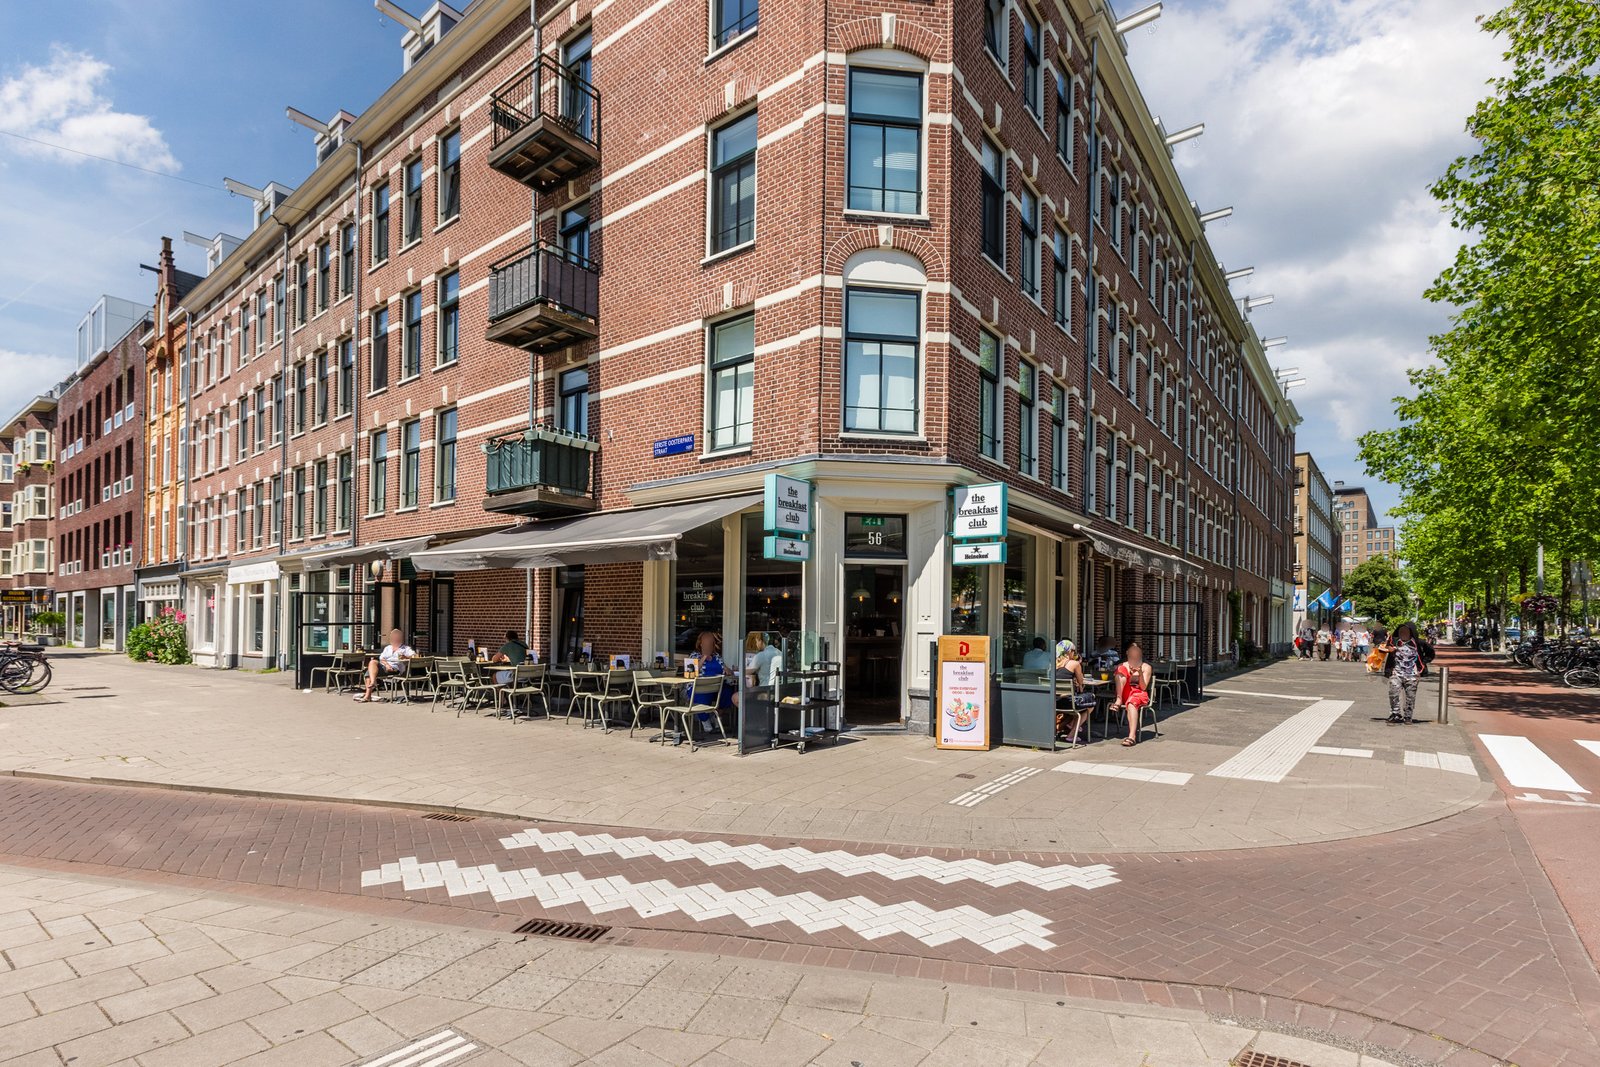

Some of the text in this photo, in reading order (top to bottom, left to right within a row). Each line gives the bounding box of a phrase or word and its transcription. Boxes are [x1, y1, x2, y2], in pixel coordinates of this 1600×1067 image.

[654, 436, 693, 449] EERSTE OOSTERPARK
[654, 447, 668, 456] STRAAT
[787, 486, 798, 496] the
[971, 493, 986, 502] the
[778, 497, 807, 511] breakfast
[958, 505, 998, 516] breakfast
[785, 512, 800, 522] club
[968, 518, 988, 528] club
[868, 531, 882, 545] 56
[783, 548, 802, 556] Heineken
[692, 580, 703, 588] the
[690, 603, 705, 611] club
